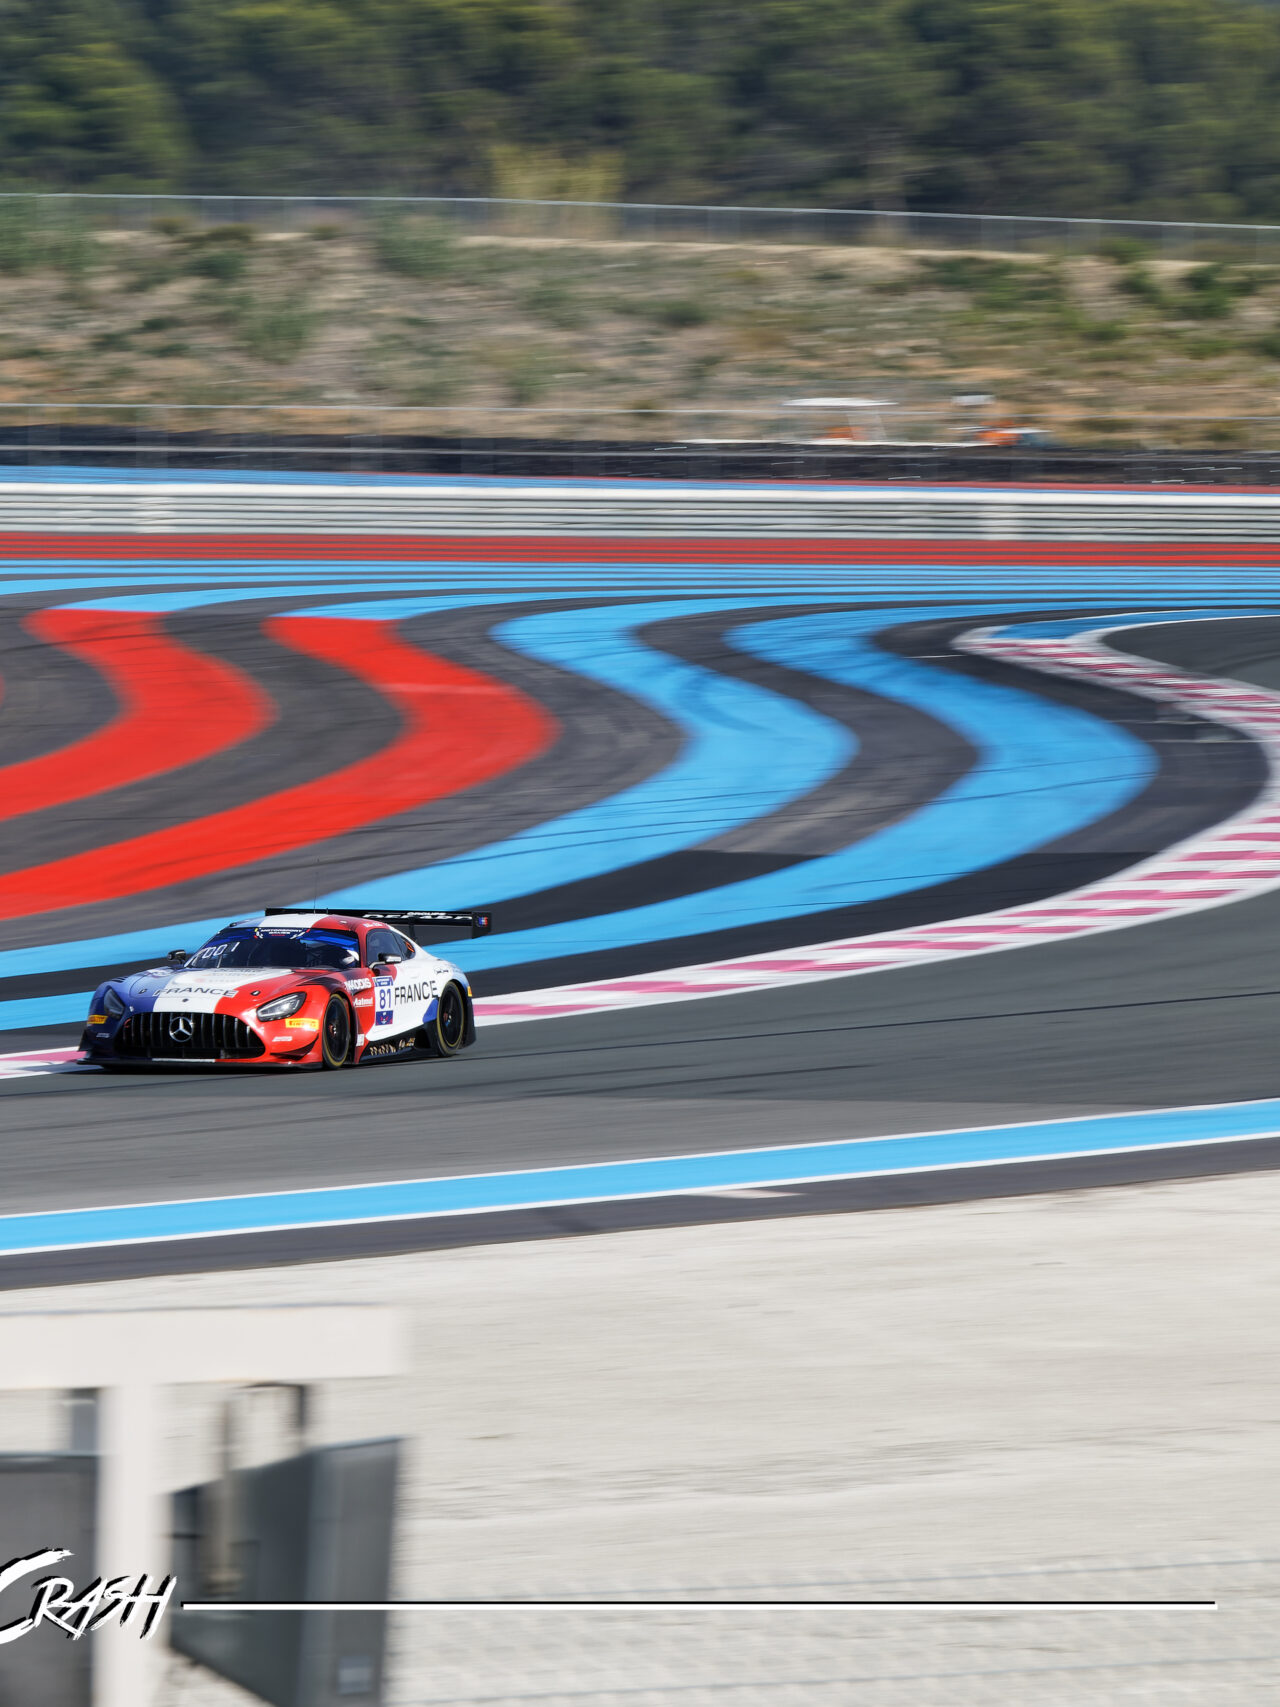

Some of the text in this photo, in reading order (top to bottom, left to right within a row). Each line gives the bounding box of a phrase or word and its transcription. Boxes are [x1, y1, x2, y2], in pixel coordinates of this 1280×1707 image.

[152, 987, 239, 998] FRANCE
[379, 988, 392, 1010] 81
[394, 980, 439, 1006] FRANCE
